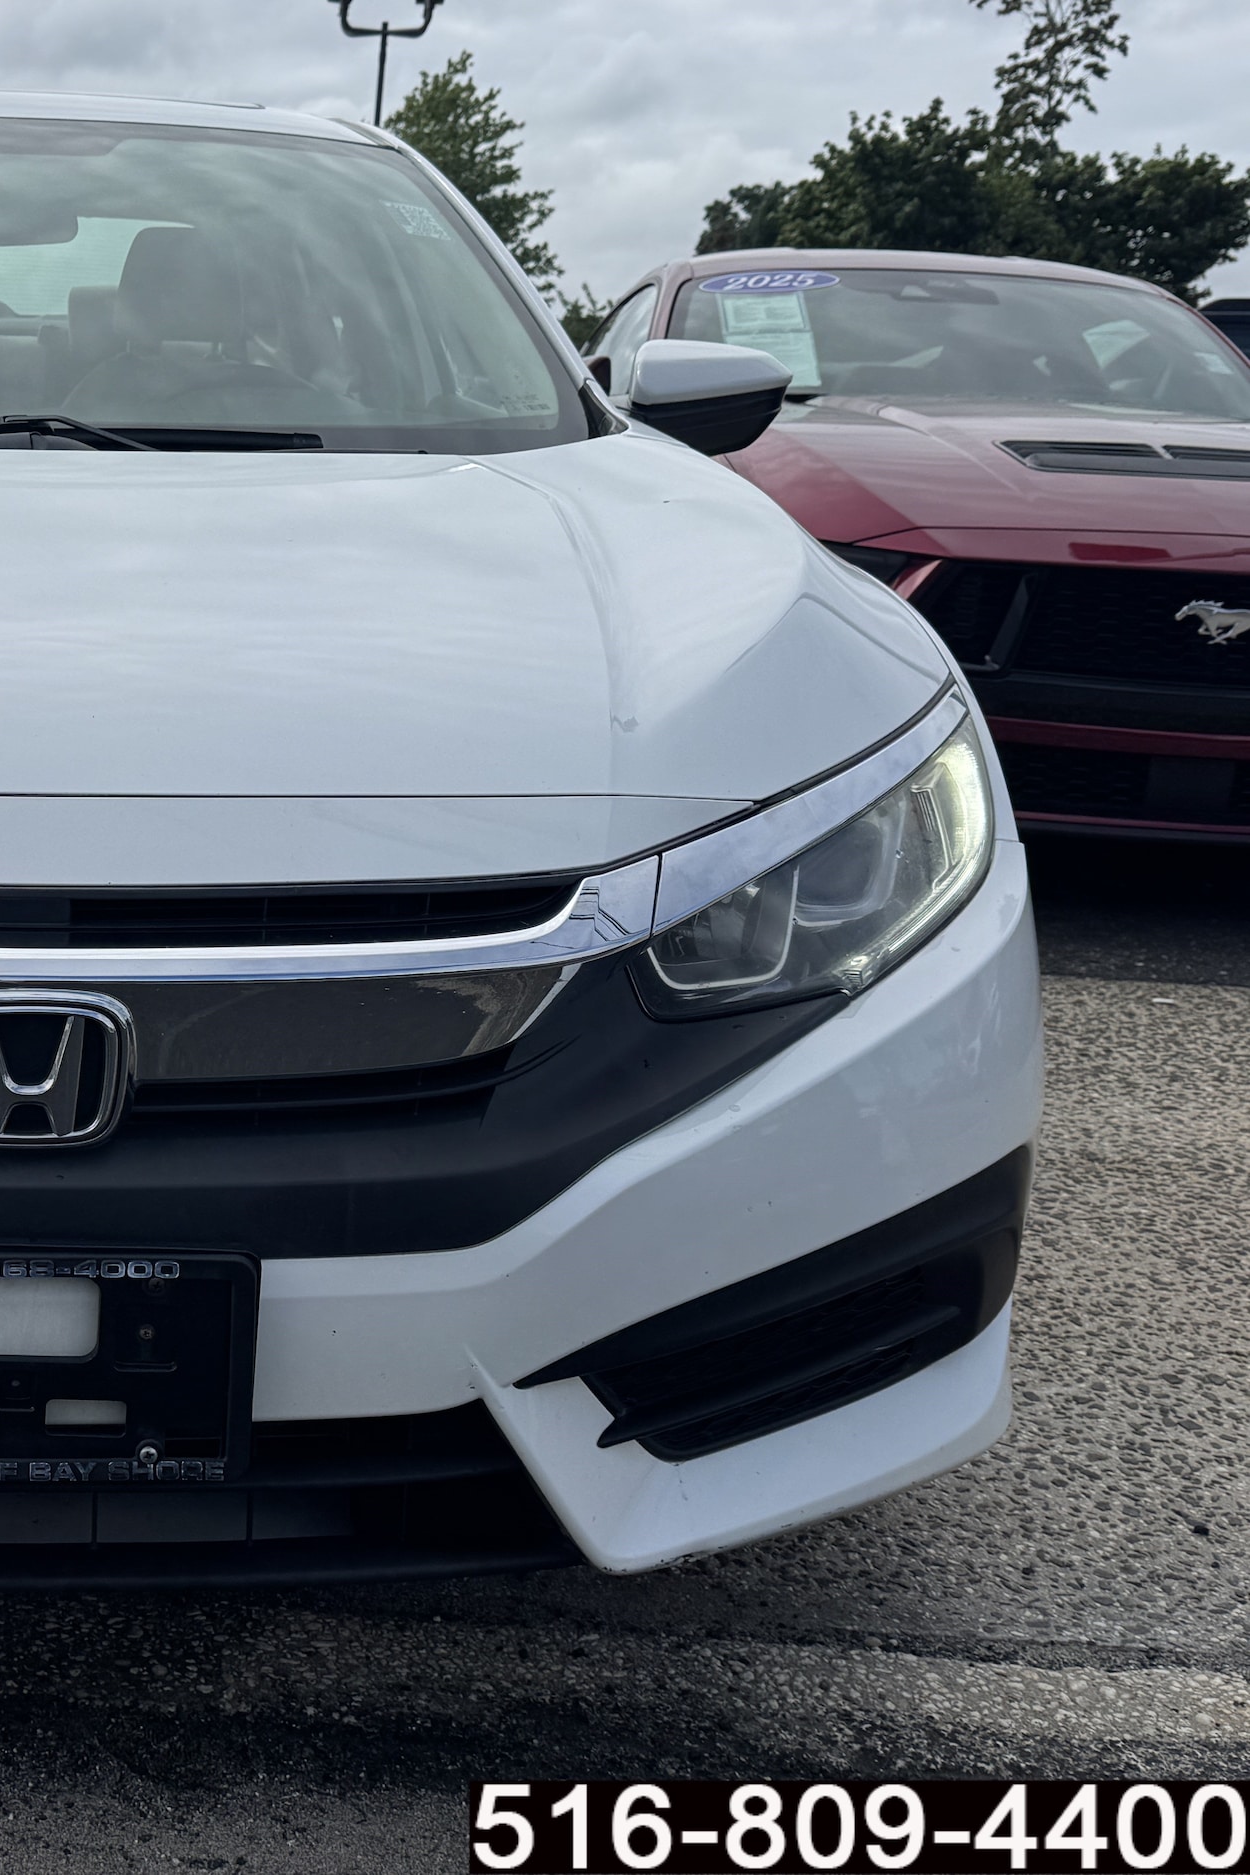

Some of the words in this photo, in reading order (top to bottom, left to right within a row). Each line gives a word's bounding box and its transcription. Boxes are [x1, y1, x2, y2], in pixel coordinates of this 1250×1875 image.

[723, 272, 818, 291] 2025
[29, 1461, 97, 1482] BAY
[107, 1460, 226, 1482] SHORE
